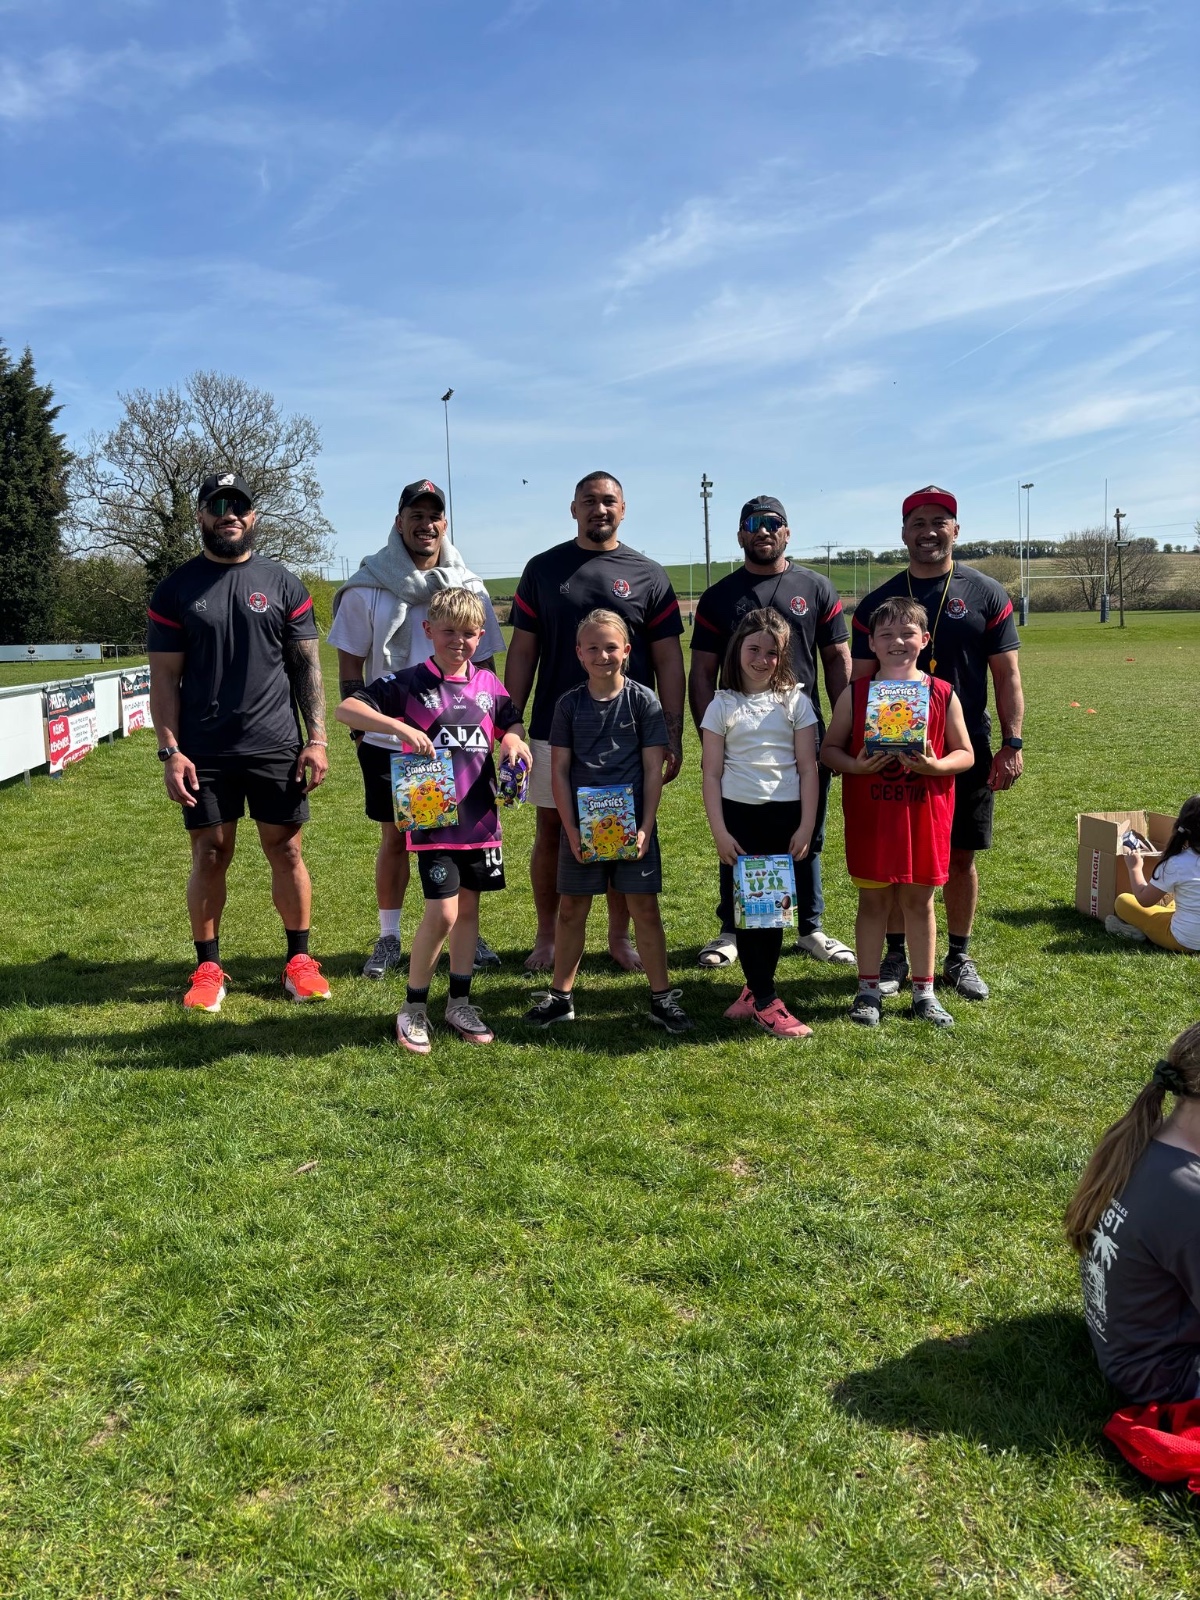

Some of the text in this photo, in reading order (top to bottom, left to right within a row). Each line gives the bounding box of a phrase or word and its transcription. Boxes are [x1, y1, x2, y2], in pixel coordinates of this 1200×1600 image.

[880, 688, 917, 697] SMARTIES
[440, 727, 481, 746] cbr
[589, 797, 624, 811] SMARTIES
[483, 846, 502, 867] 10
